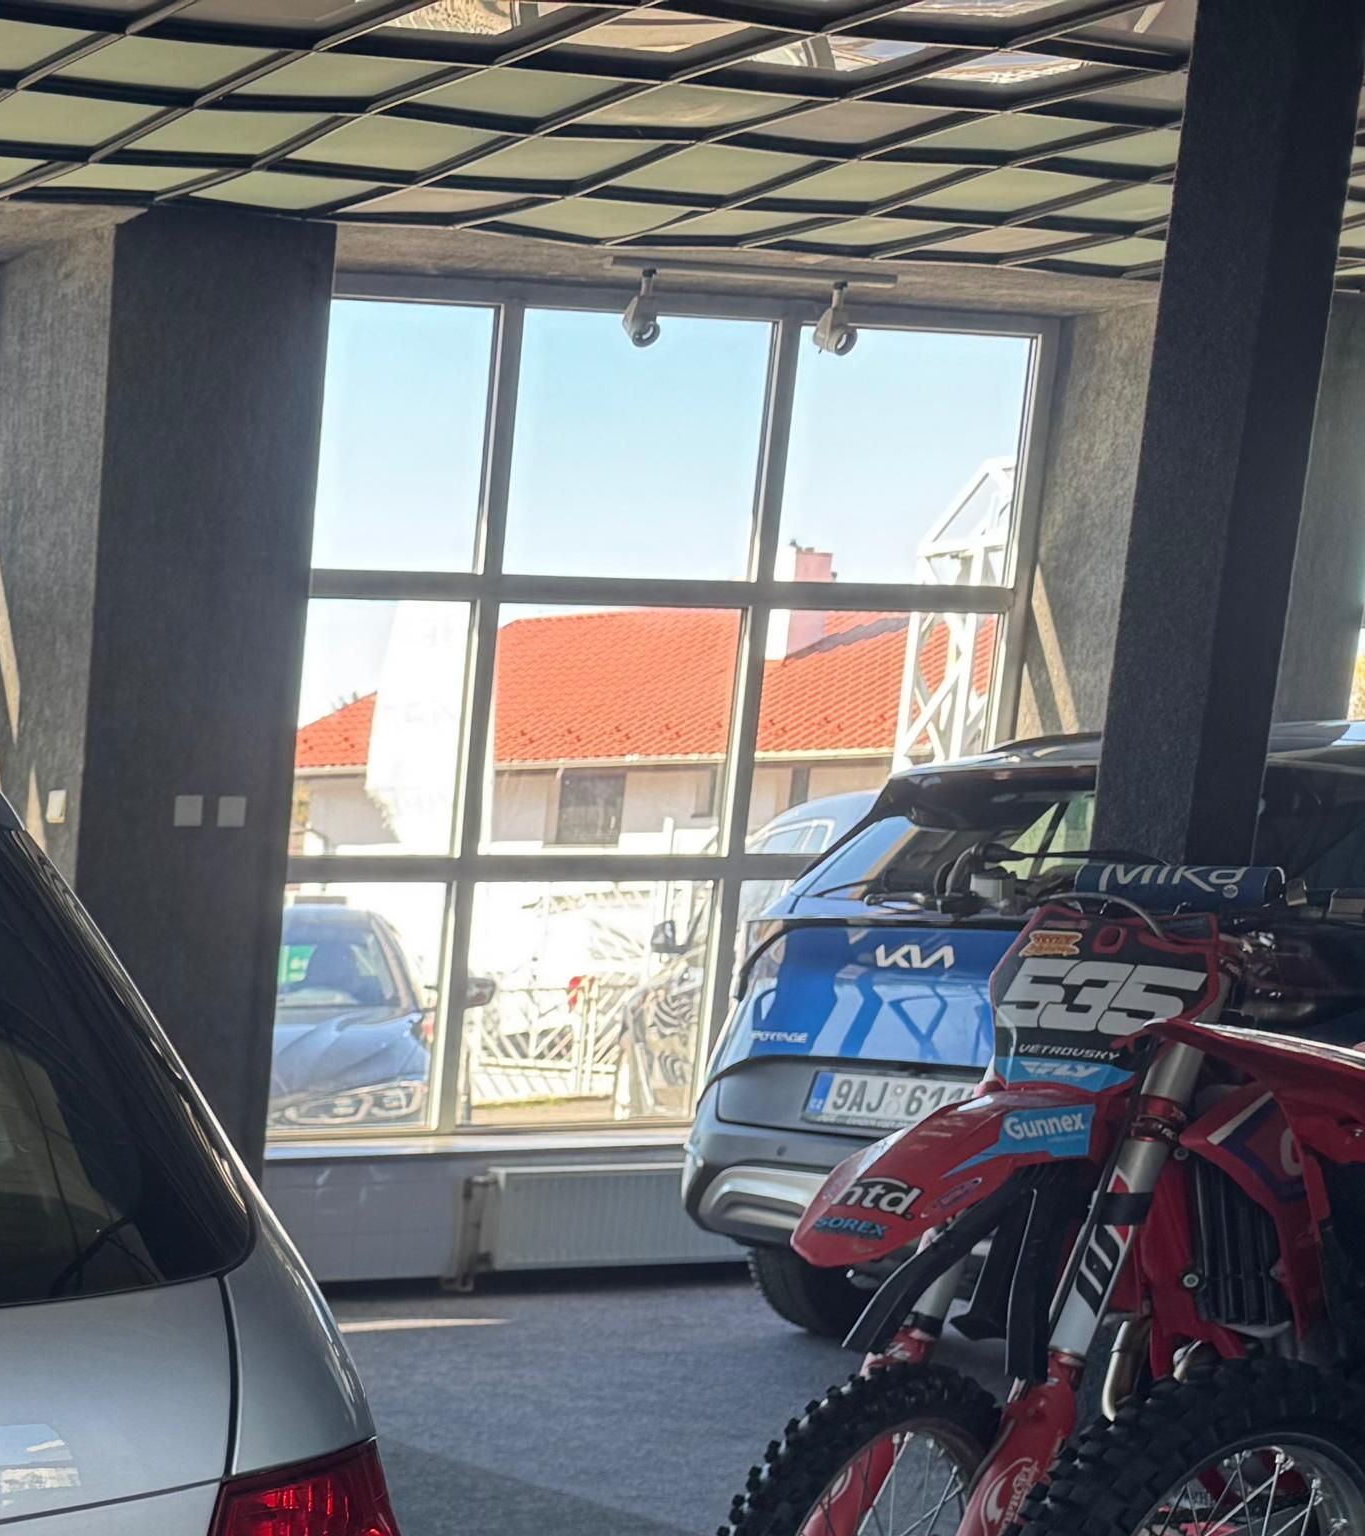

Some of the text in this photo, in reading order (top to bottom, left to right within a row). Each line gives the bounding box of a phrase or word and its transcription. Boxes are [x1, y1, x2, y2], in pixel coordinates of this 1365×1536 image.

[995, 957, 1208, 1036] 535
[831, 1078, 890, 1113] 9AJ
[1003, 1112, 1085, 1141] Gunnex
